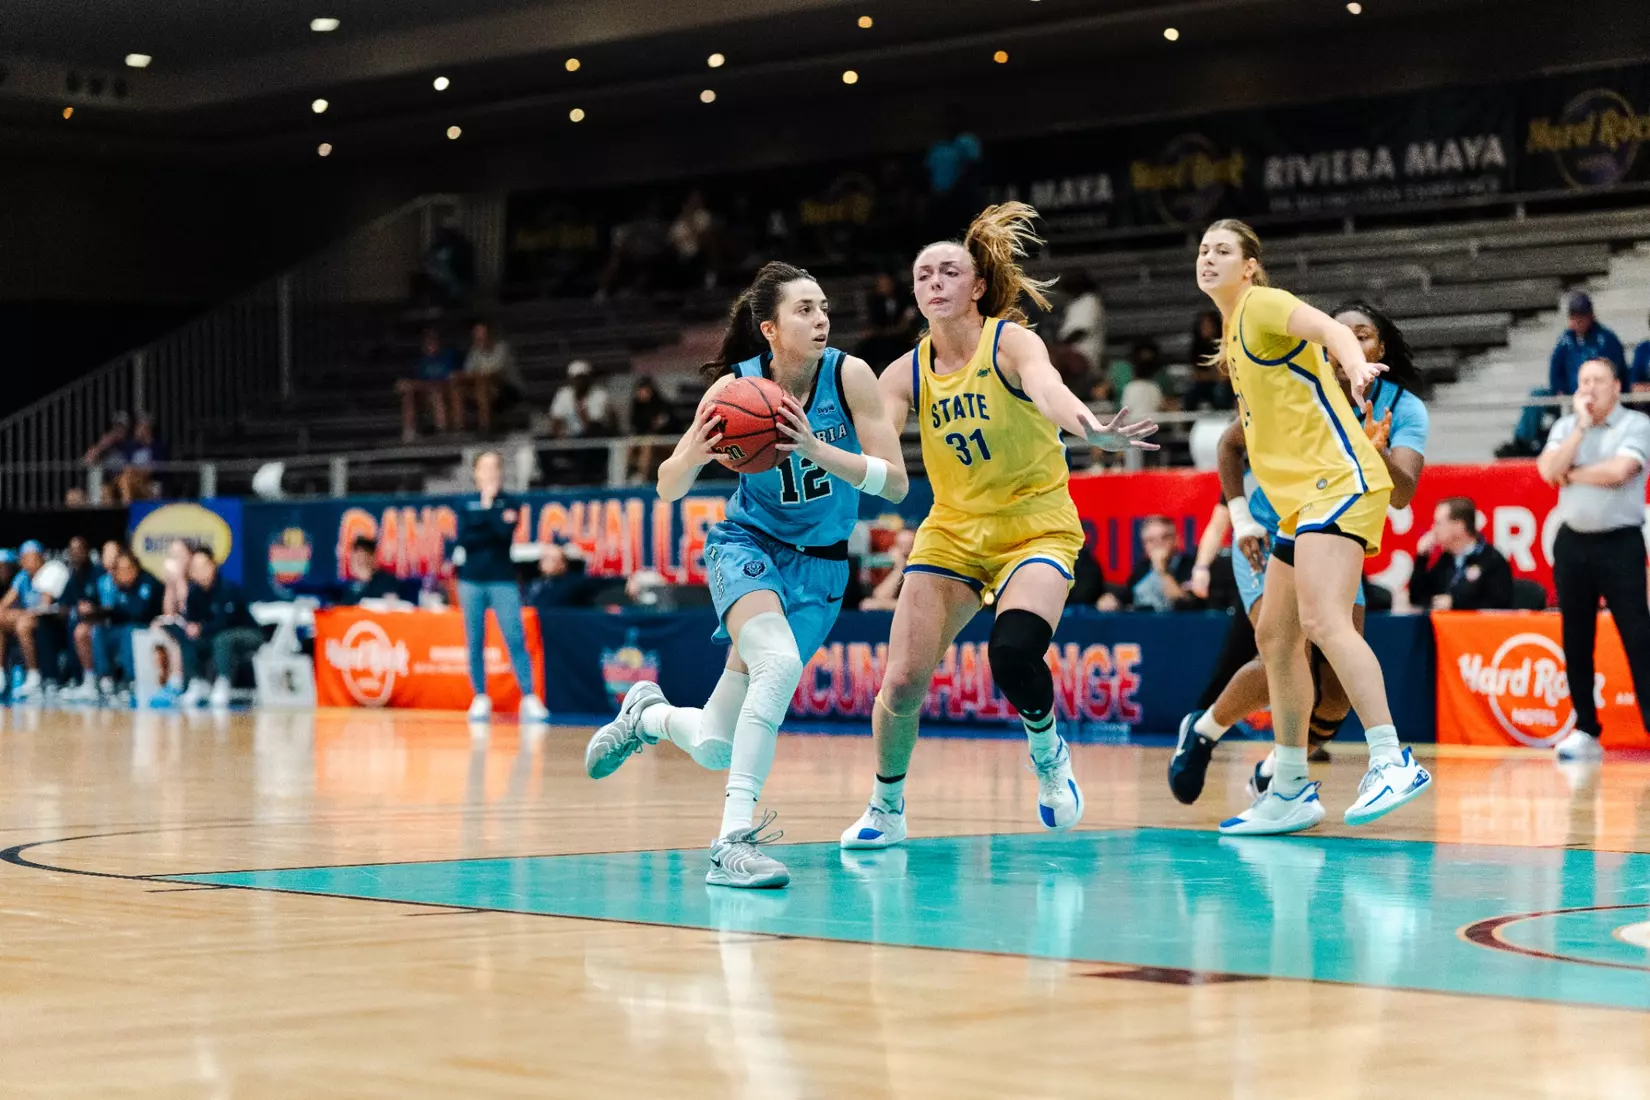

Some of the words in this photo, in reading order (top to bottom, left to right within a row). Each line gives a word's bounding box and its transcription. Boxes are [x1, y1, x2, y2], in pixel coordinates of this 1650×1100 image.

[1598, 108, 1650, 152] Roc
[1263, 145, 1396, 190] RIVIERA
[1404, 133, 1507, 178] MAYA
[814, 422, 848, 443] BIA
[931, 393, 990, 429] STATE
[945, 428, 993, 467] 31
[776, 455, 833, 505] 12
[538, 496, 728, 585] CHALLE
[918, 639, 1144, 724] HALNGE
[1458, 653, 1532, 697] Hard
